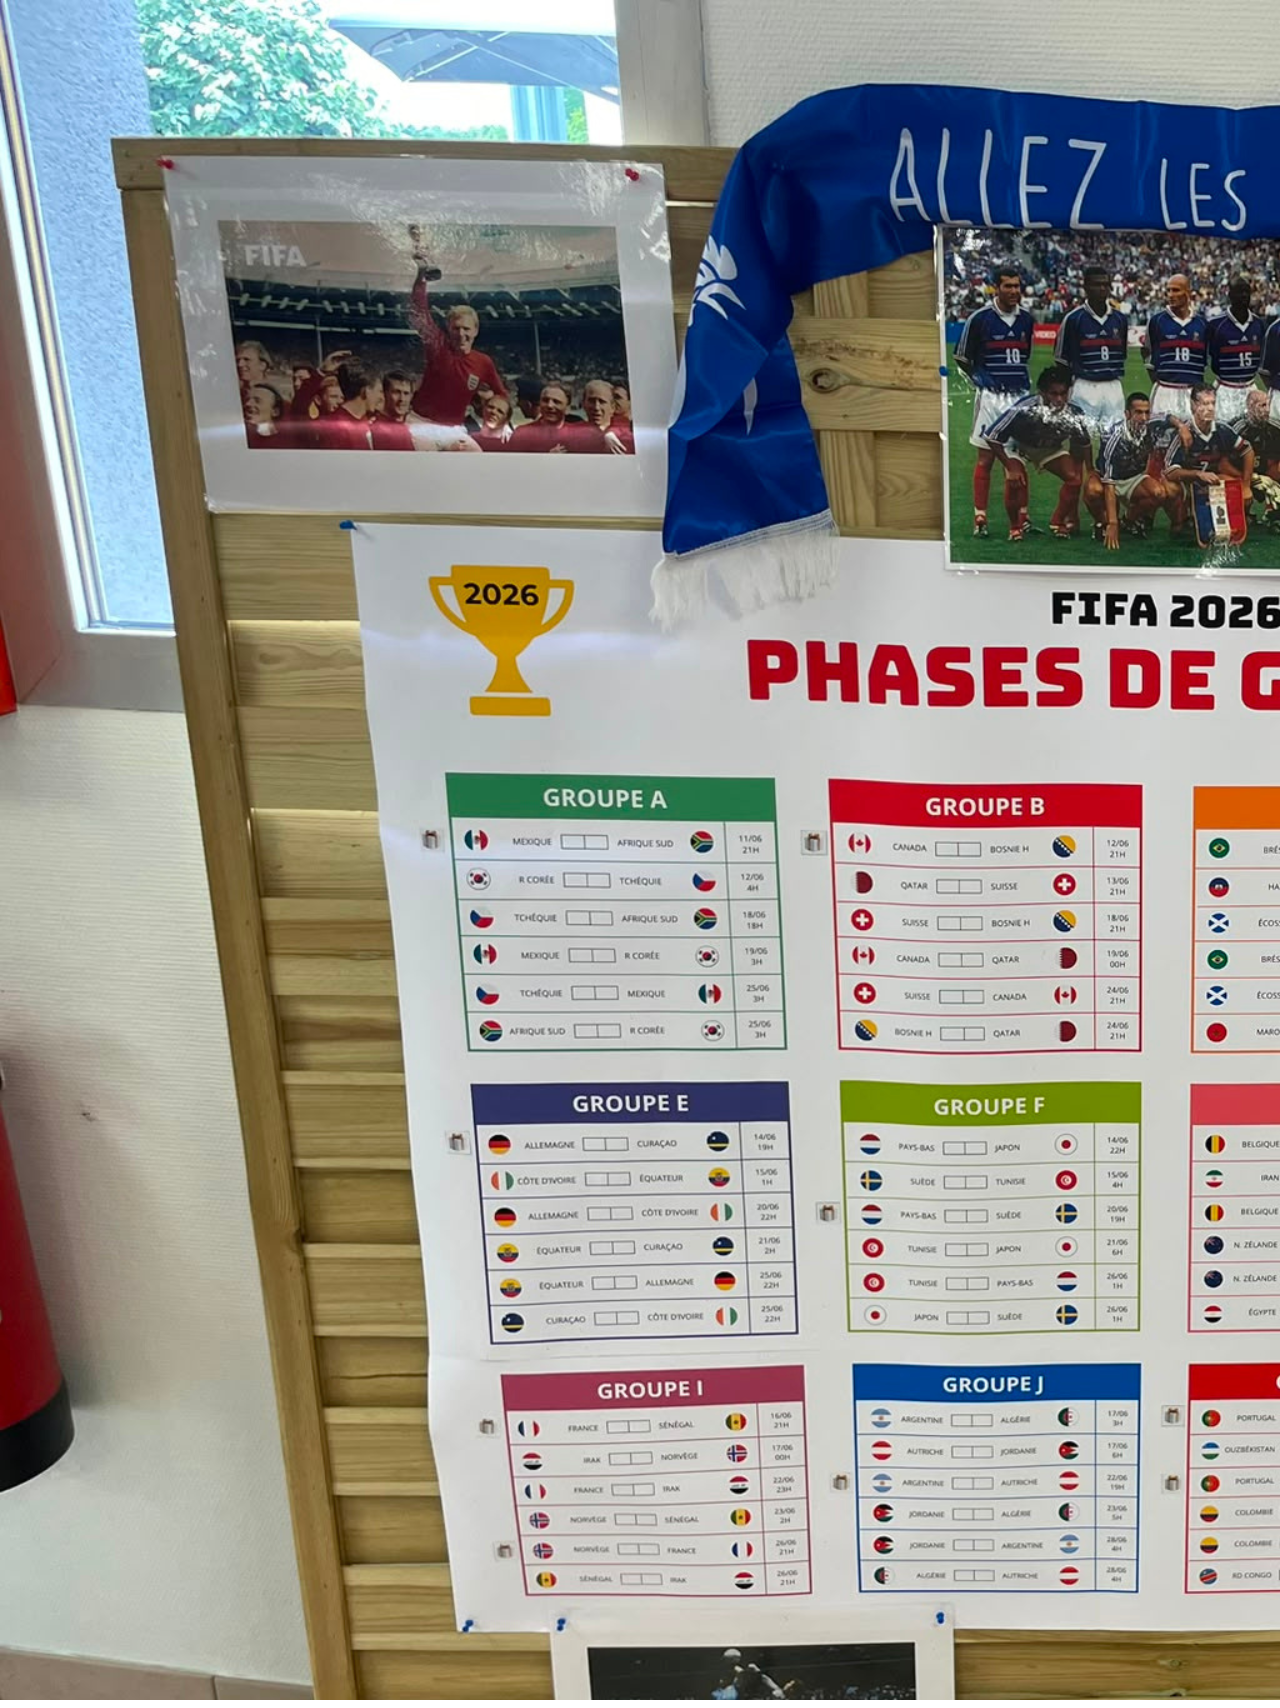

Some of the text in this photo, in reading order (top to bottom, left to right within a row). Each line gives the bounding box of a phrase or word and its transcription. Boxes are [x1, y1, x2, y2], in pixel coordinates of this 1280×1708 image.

[889, 127, 1107, 230] ALLEZ
[1159, 158, 1246, 231] LES
[245, 245, 306, 267] FIFA
[1005, 348, 1020, 363] 10
[1100, 346, 1109, 360] 8
[1239, 352, 1252, 366] 15
[463, 583, 539, 606] 2026
[1052, 592, 1159, 626] FIFA
[747, 639, 1082, 708] PHASES
[1109, 649, 1215, 709] DE
[544, 788, 667, 809] GROUPE A
[926, 797, 1044, 816] GROUPE B
[512, 838, 551, 846] MEXIQUE
[617, 839, 653, 848] AFRIQUE
[739, 835, 762, 843] 11/06
[743, 846, 759, 854] 21H
[893, 843, 927, 852] CANADA
[990, 845, 1020, 853] BOSNIE
[1110, 850, 1125, 858] 21H
[741, 873, 764, 881] 12/06
[1107, 877, 1129, 885] 13/06
[901, 881, 928, 890] QATAR
[573, 1095, 688, 1112] GROUPE E
[934, 1097, 1045, 1115] GROUPE F
[525, 1141, 575, 1149] ALLEMAGNE
[899, 1143, 1020, 1153] PAYS-BAS JAPON
[1242, 1141, 1279, 1149] BELGIQUE
[756, 1168, 778, 1176] 15/06
[1241, 1208, 1278, 1216] BELGIQUE
[598, 1380, 702, 1399] GROUPE I
[943, 1376, 1043, 1395] GROUPE J
[901, 1416, 943, 1424] ARGENTINE
[1000, 1447, 1036, 1456] JORDANIE
